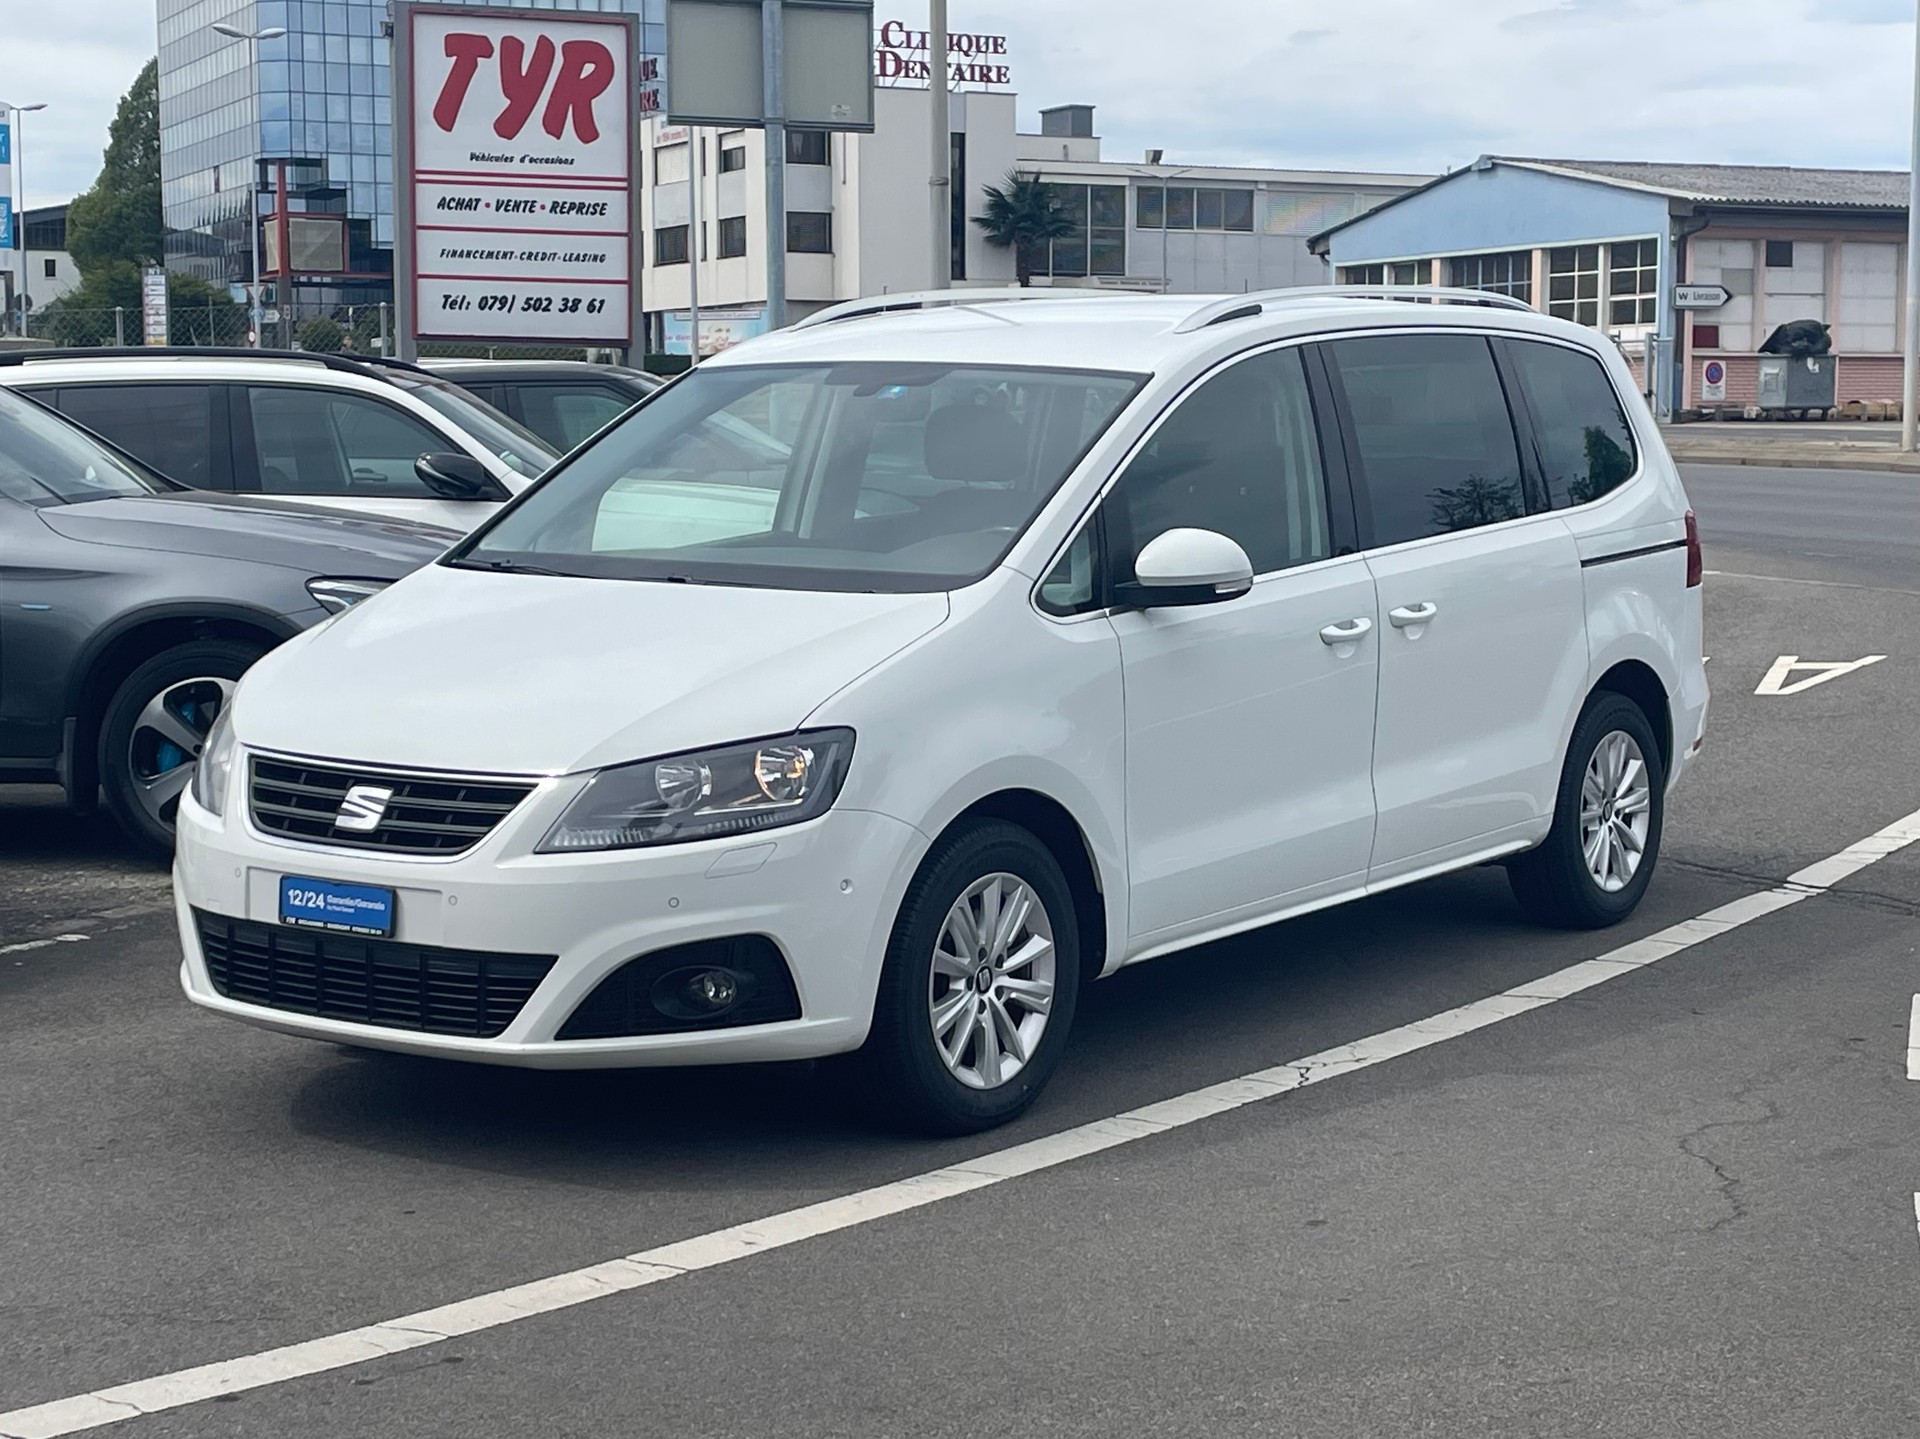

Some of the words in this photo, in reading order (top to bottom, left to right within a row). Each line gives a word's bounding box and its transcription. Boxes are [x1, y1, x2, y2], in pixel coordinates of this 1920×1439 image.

[881, 20, 1007, 56] CLIIQUE
[433, 33, 615, 144] TYR
[469, 151, 515, 163] Véhicules
[437, 196, 482, 212] ACHAT
[495, 199, 537, 214] VENTE
[549, 200, 608, 217] REPRISE
[520, 296, 553, 314] 502
[558, 297, 582, 314] 38
[586, 298, 606, 315] 61
[287, 888, 326, 910] 12/24
